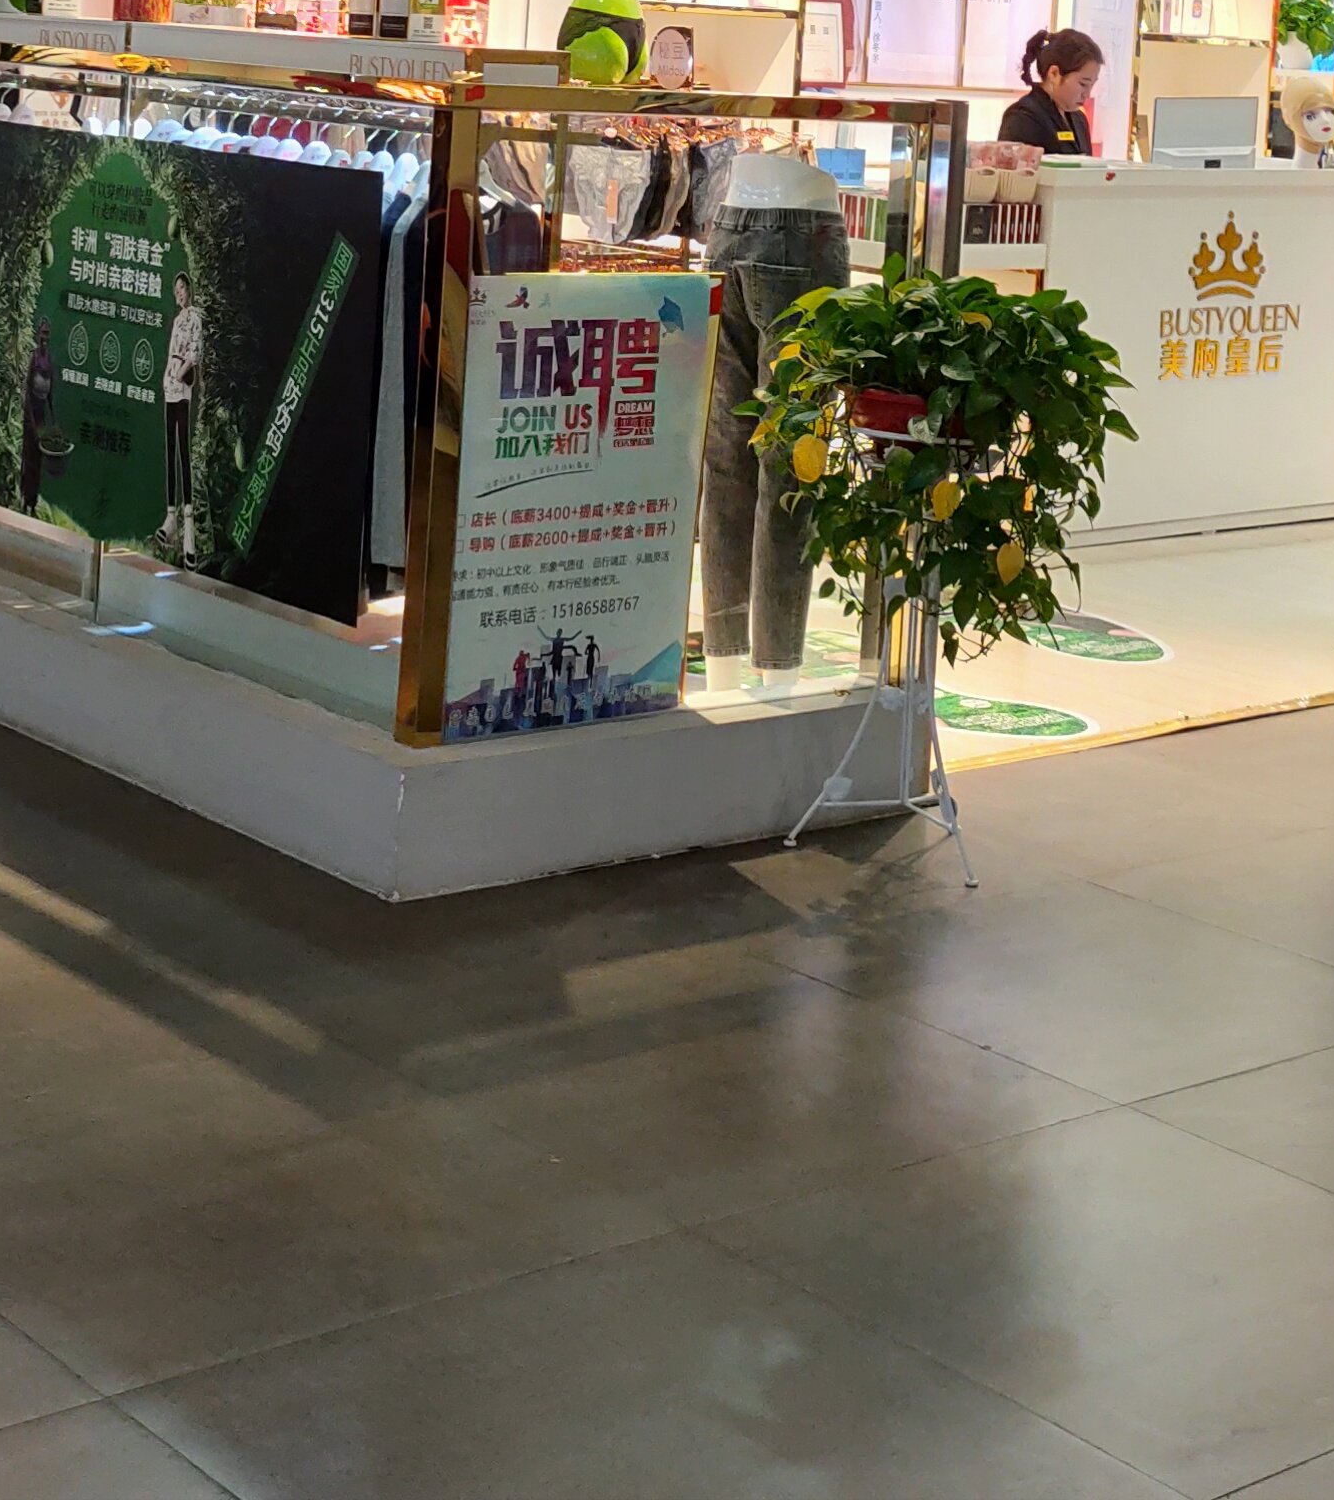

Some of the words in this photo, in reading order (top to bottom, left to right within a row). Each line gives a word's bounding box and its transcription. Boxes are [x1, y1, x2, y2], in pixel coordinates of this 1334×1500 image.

[71, 226, 98, 254] 非洲
[70, 257, 162, 298] 与时尚亲密接触
[1160, 304, 1301, 338] BUSTYQUEEN
[496, 318, 661, 418] 诚聘
[1158, 334, 1284, 381] 美胸皇后
[496, 404, 557, 433] JOIN
[564, 403, 593, 430] US
[617, 401, 653, 414] DREAM
[495, 432, 590, 459] 加入我们
